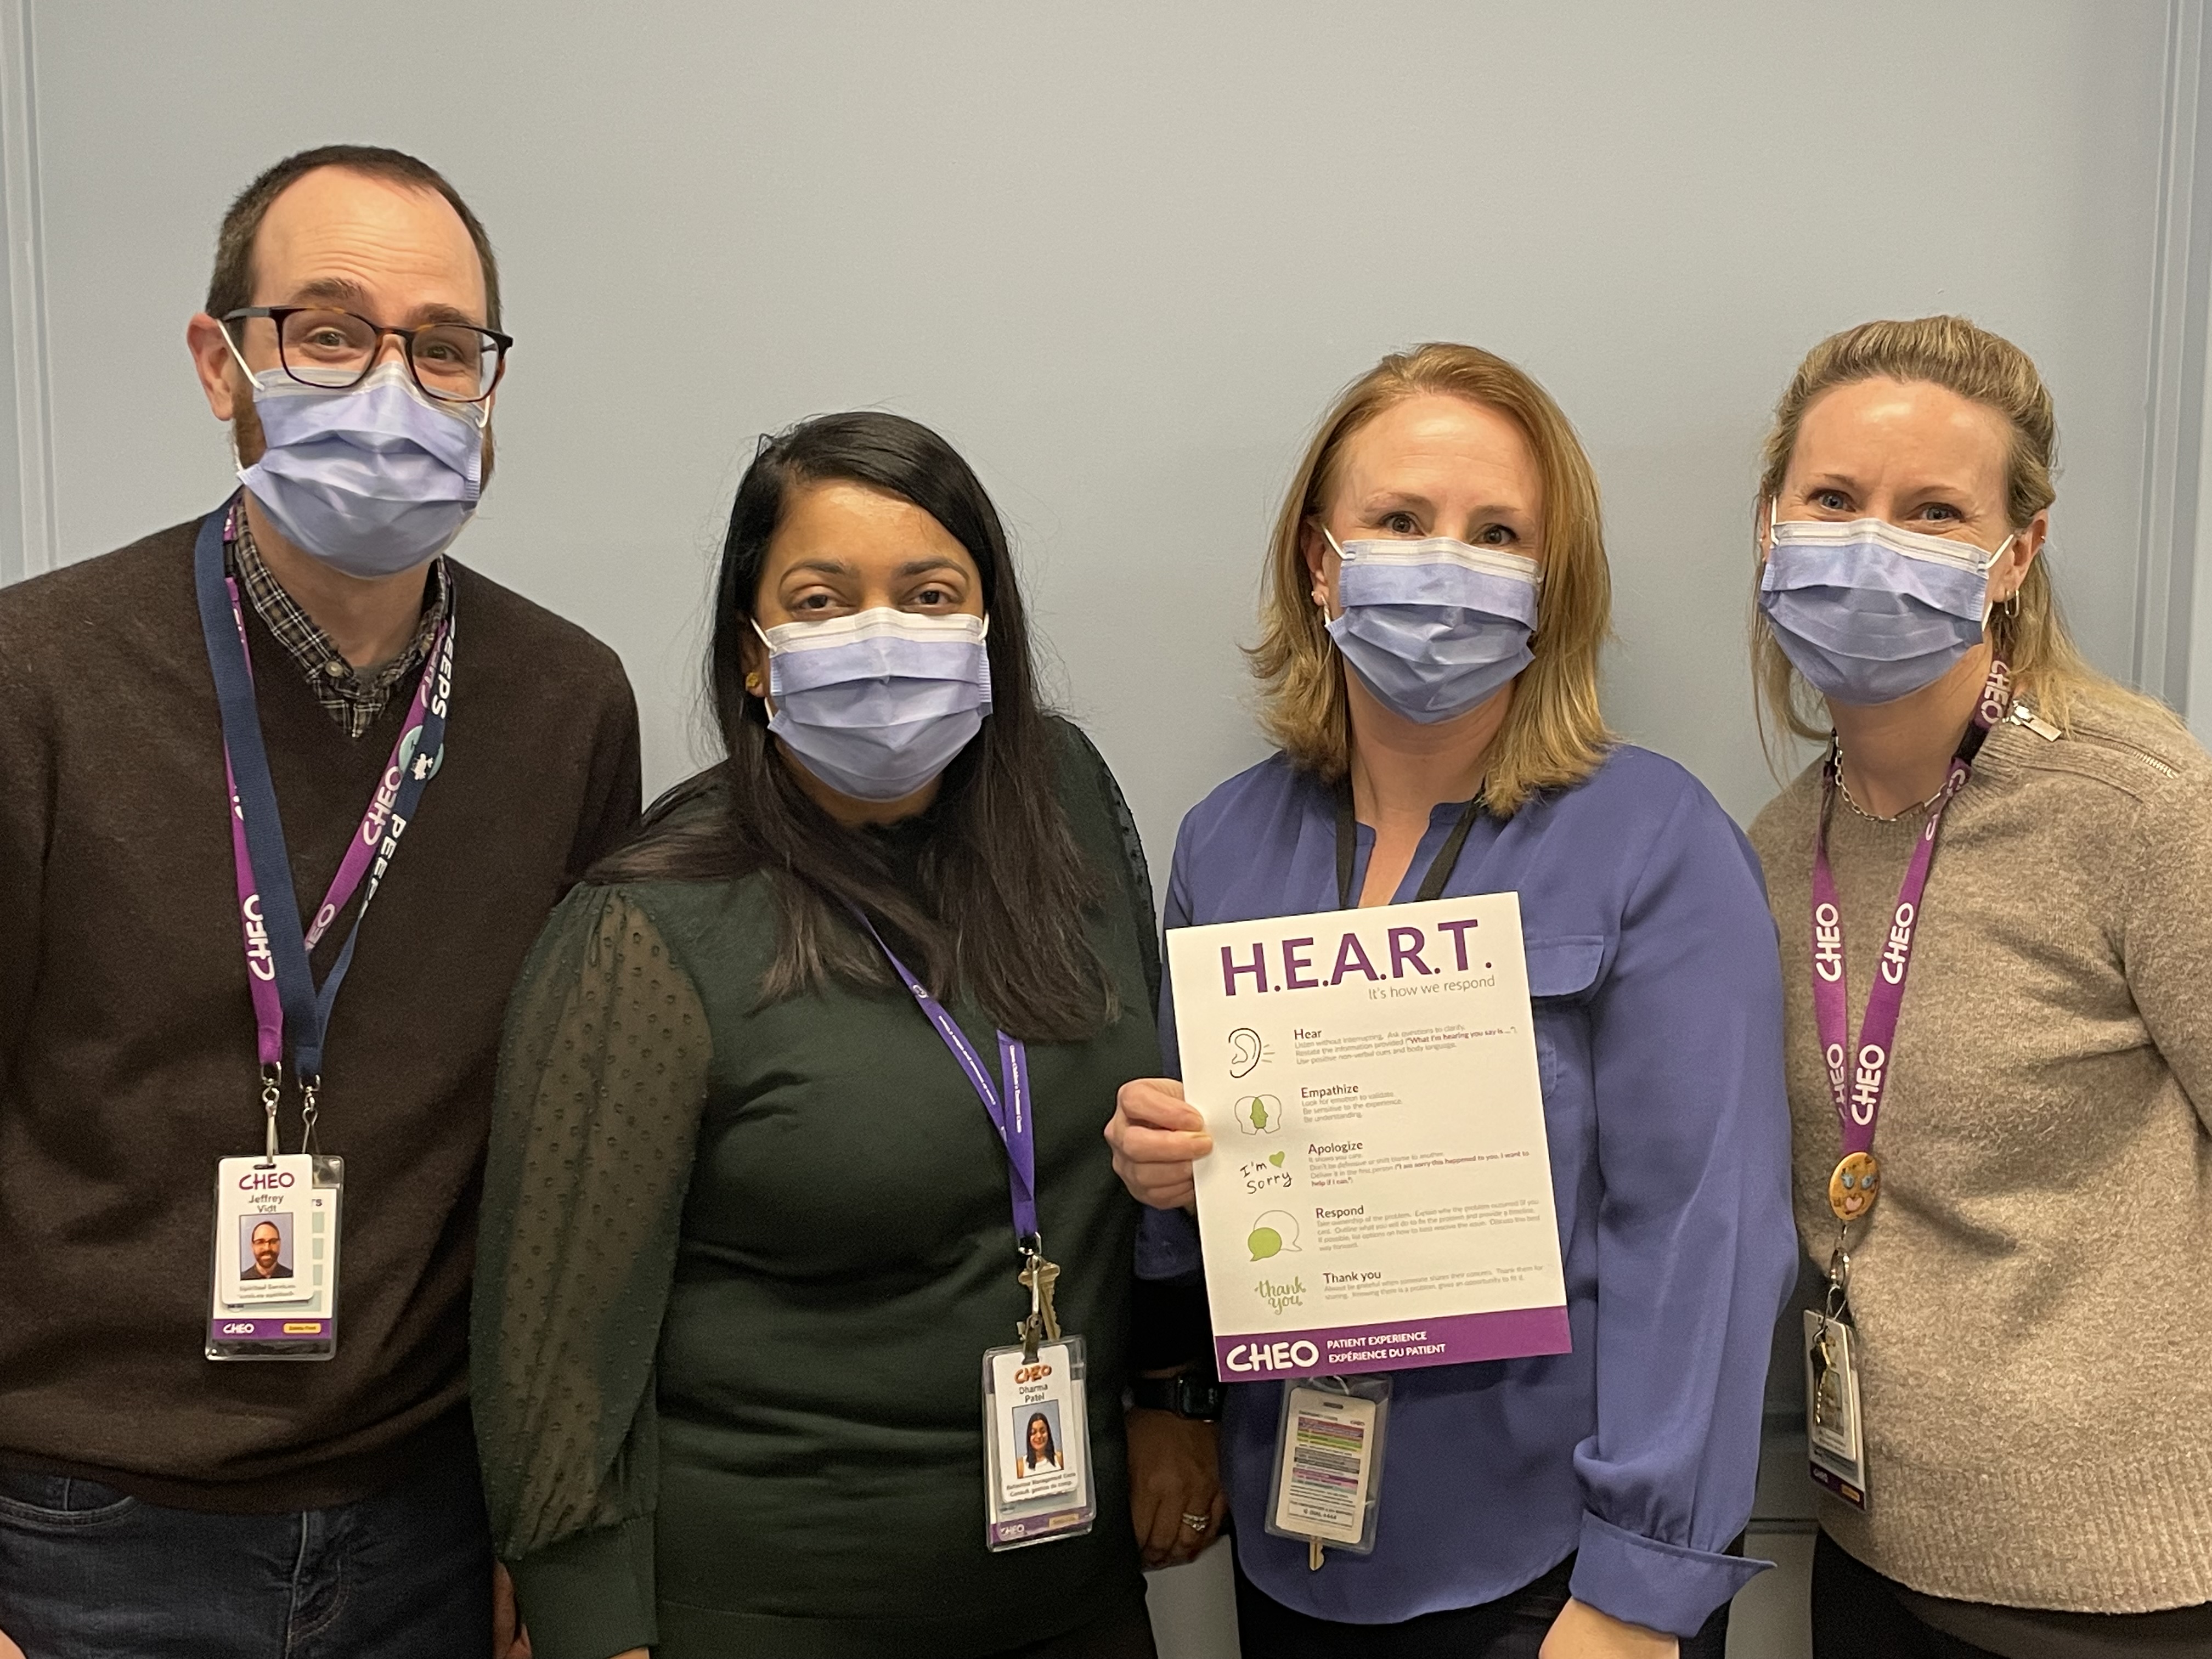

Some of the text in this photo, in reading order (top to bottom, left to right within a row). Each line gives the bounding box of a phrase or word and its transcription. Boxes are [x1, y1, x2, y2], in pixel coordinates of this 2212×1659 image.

[1981, 660, 2011, 724] CHEO
[363, 766, 403, 845] CHEO
[1815, 903, 1842, 981] CHEO
[1882, 902, 1915, 984] CHEO
[1220, 919, 1492, 996] H.E.A.R.T.
[1369, 974, 1494, 1000] It's how we respond
[1294, 1028, 1322, 1040] Hear
[1301, 1084, 1358, 1098] Empathize
[1851, 1045, 1884, 1125] CHEO
[1308, 1141, 1363, 1156] Apologize
[1239, 1161, 1267, 1178] I'm
[239, 1172, 295, 1190] CHEO
[1246, 1172, 1293, 1194] Sorry
[249, 1194, 284, 1204] Jeffrey
[1316, 1204, 1364, 1218] Respond
[1254, 1276, 1307, 1298] thank
[1322, 1271, 1381, 1284] Thank you
[1268, 1295, 1304, 1316] you
[223, 1323, 255, 1334] CHEO
[1327, 1331, 1427, 1349] PATIENT EXPERIENCE
[1226, 1340, 1319, 1372] CHEO
[1329, 1344, 1446, 1364] EXPÉRIENCE DU PATIENT
[1014, 1365, 1052, 1384] CHEO
[1019, 1384, 1048, 1395] Dharma
[1025, 1392, 1045, 1403] Patel
